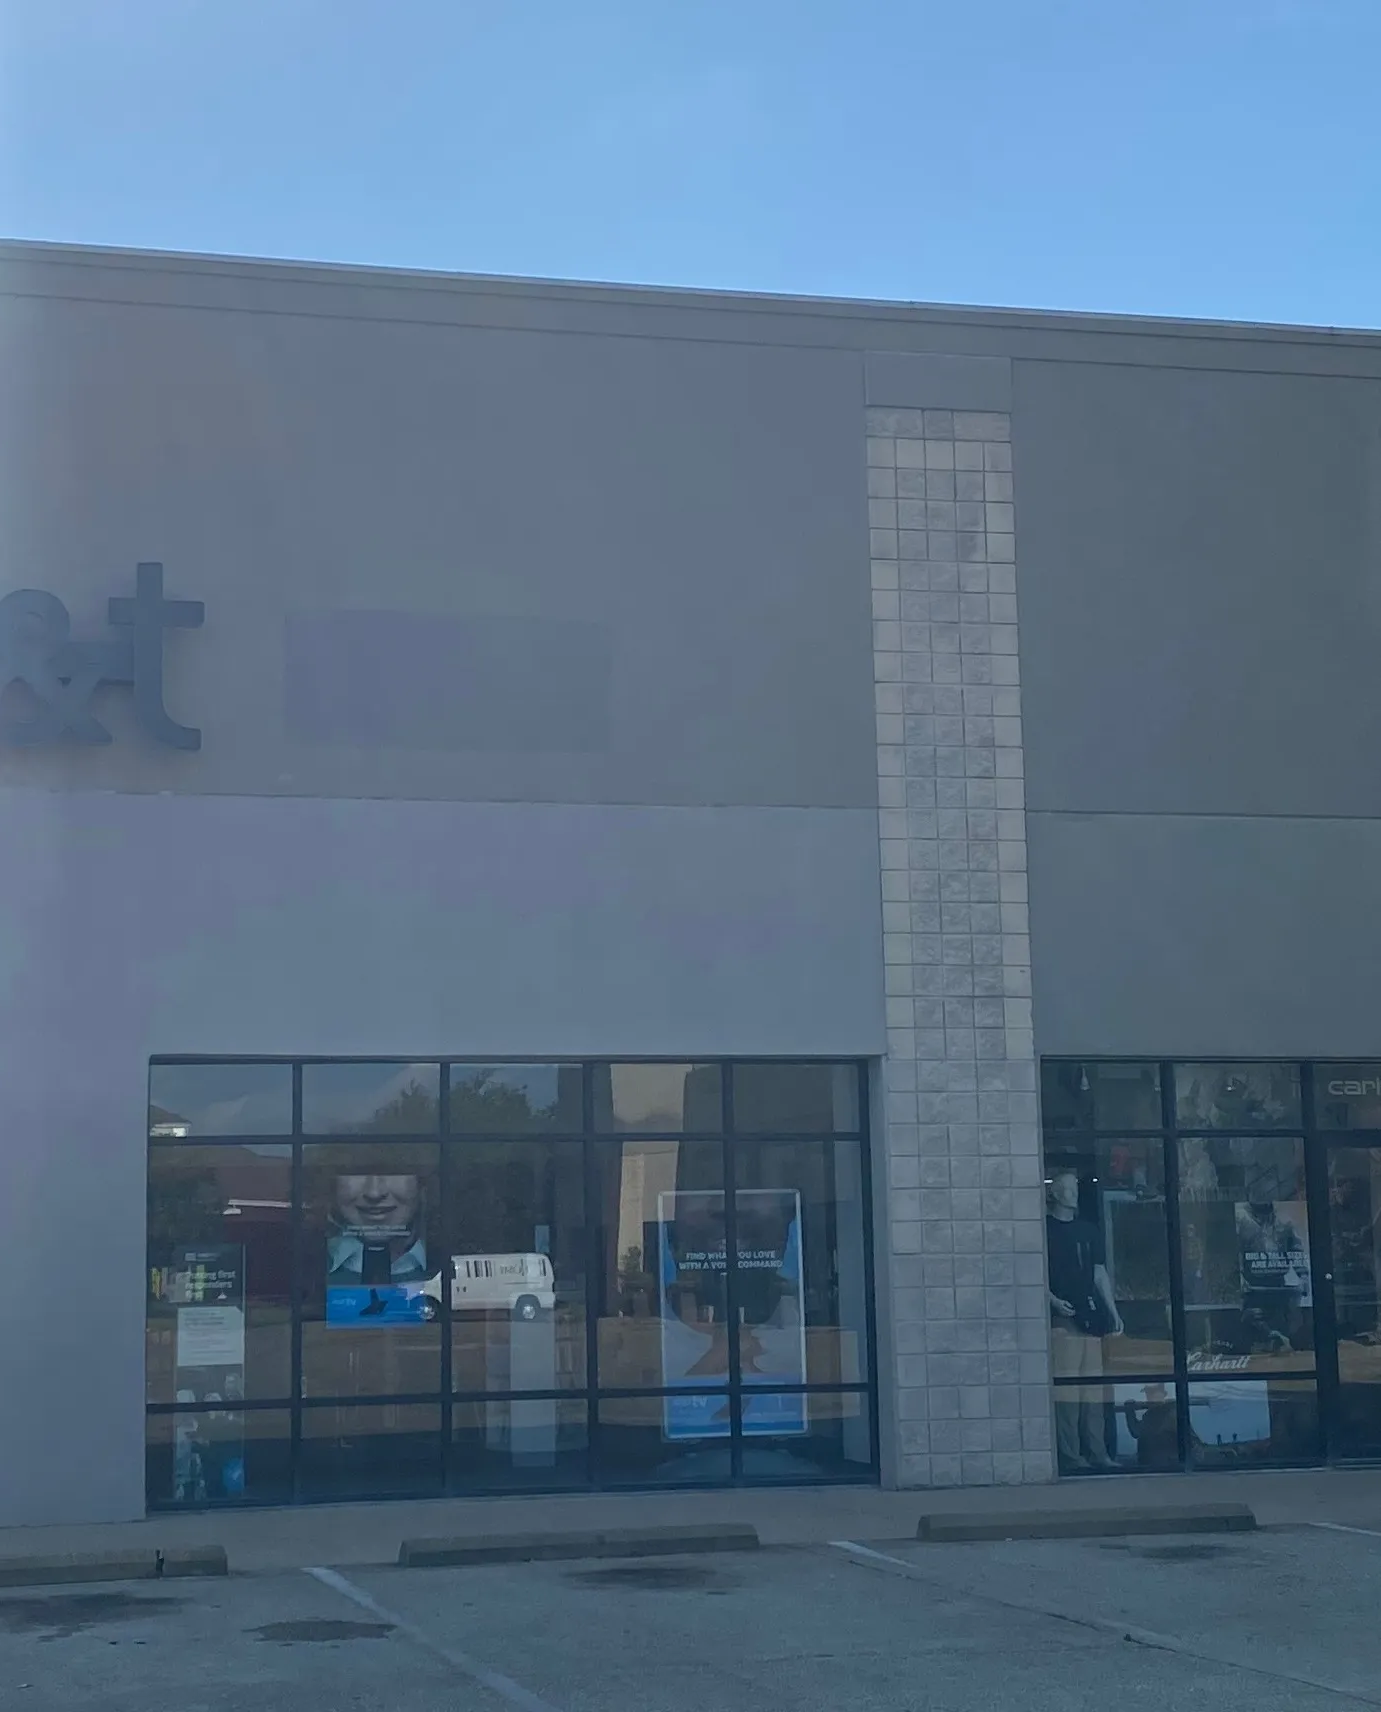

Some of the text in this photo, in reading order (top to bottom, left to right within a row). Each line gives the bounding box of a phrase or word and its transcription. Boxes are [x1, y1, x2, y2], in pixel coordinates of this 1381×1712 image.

[707, 1251, 727, 1260] WHA
[753, 1250, 776, 1259] LOVE
[678, 1261, 702, 1270] WITH
[702, 1261, 710, 1270] A
[737, 1259, 784, 1269] COMMAND
[1186, 1350, 1252, 1371] Carhartt
